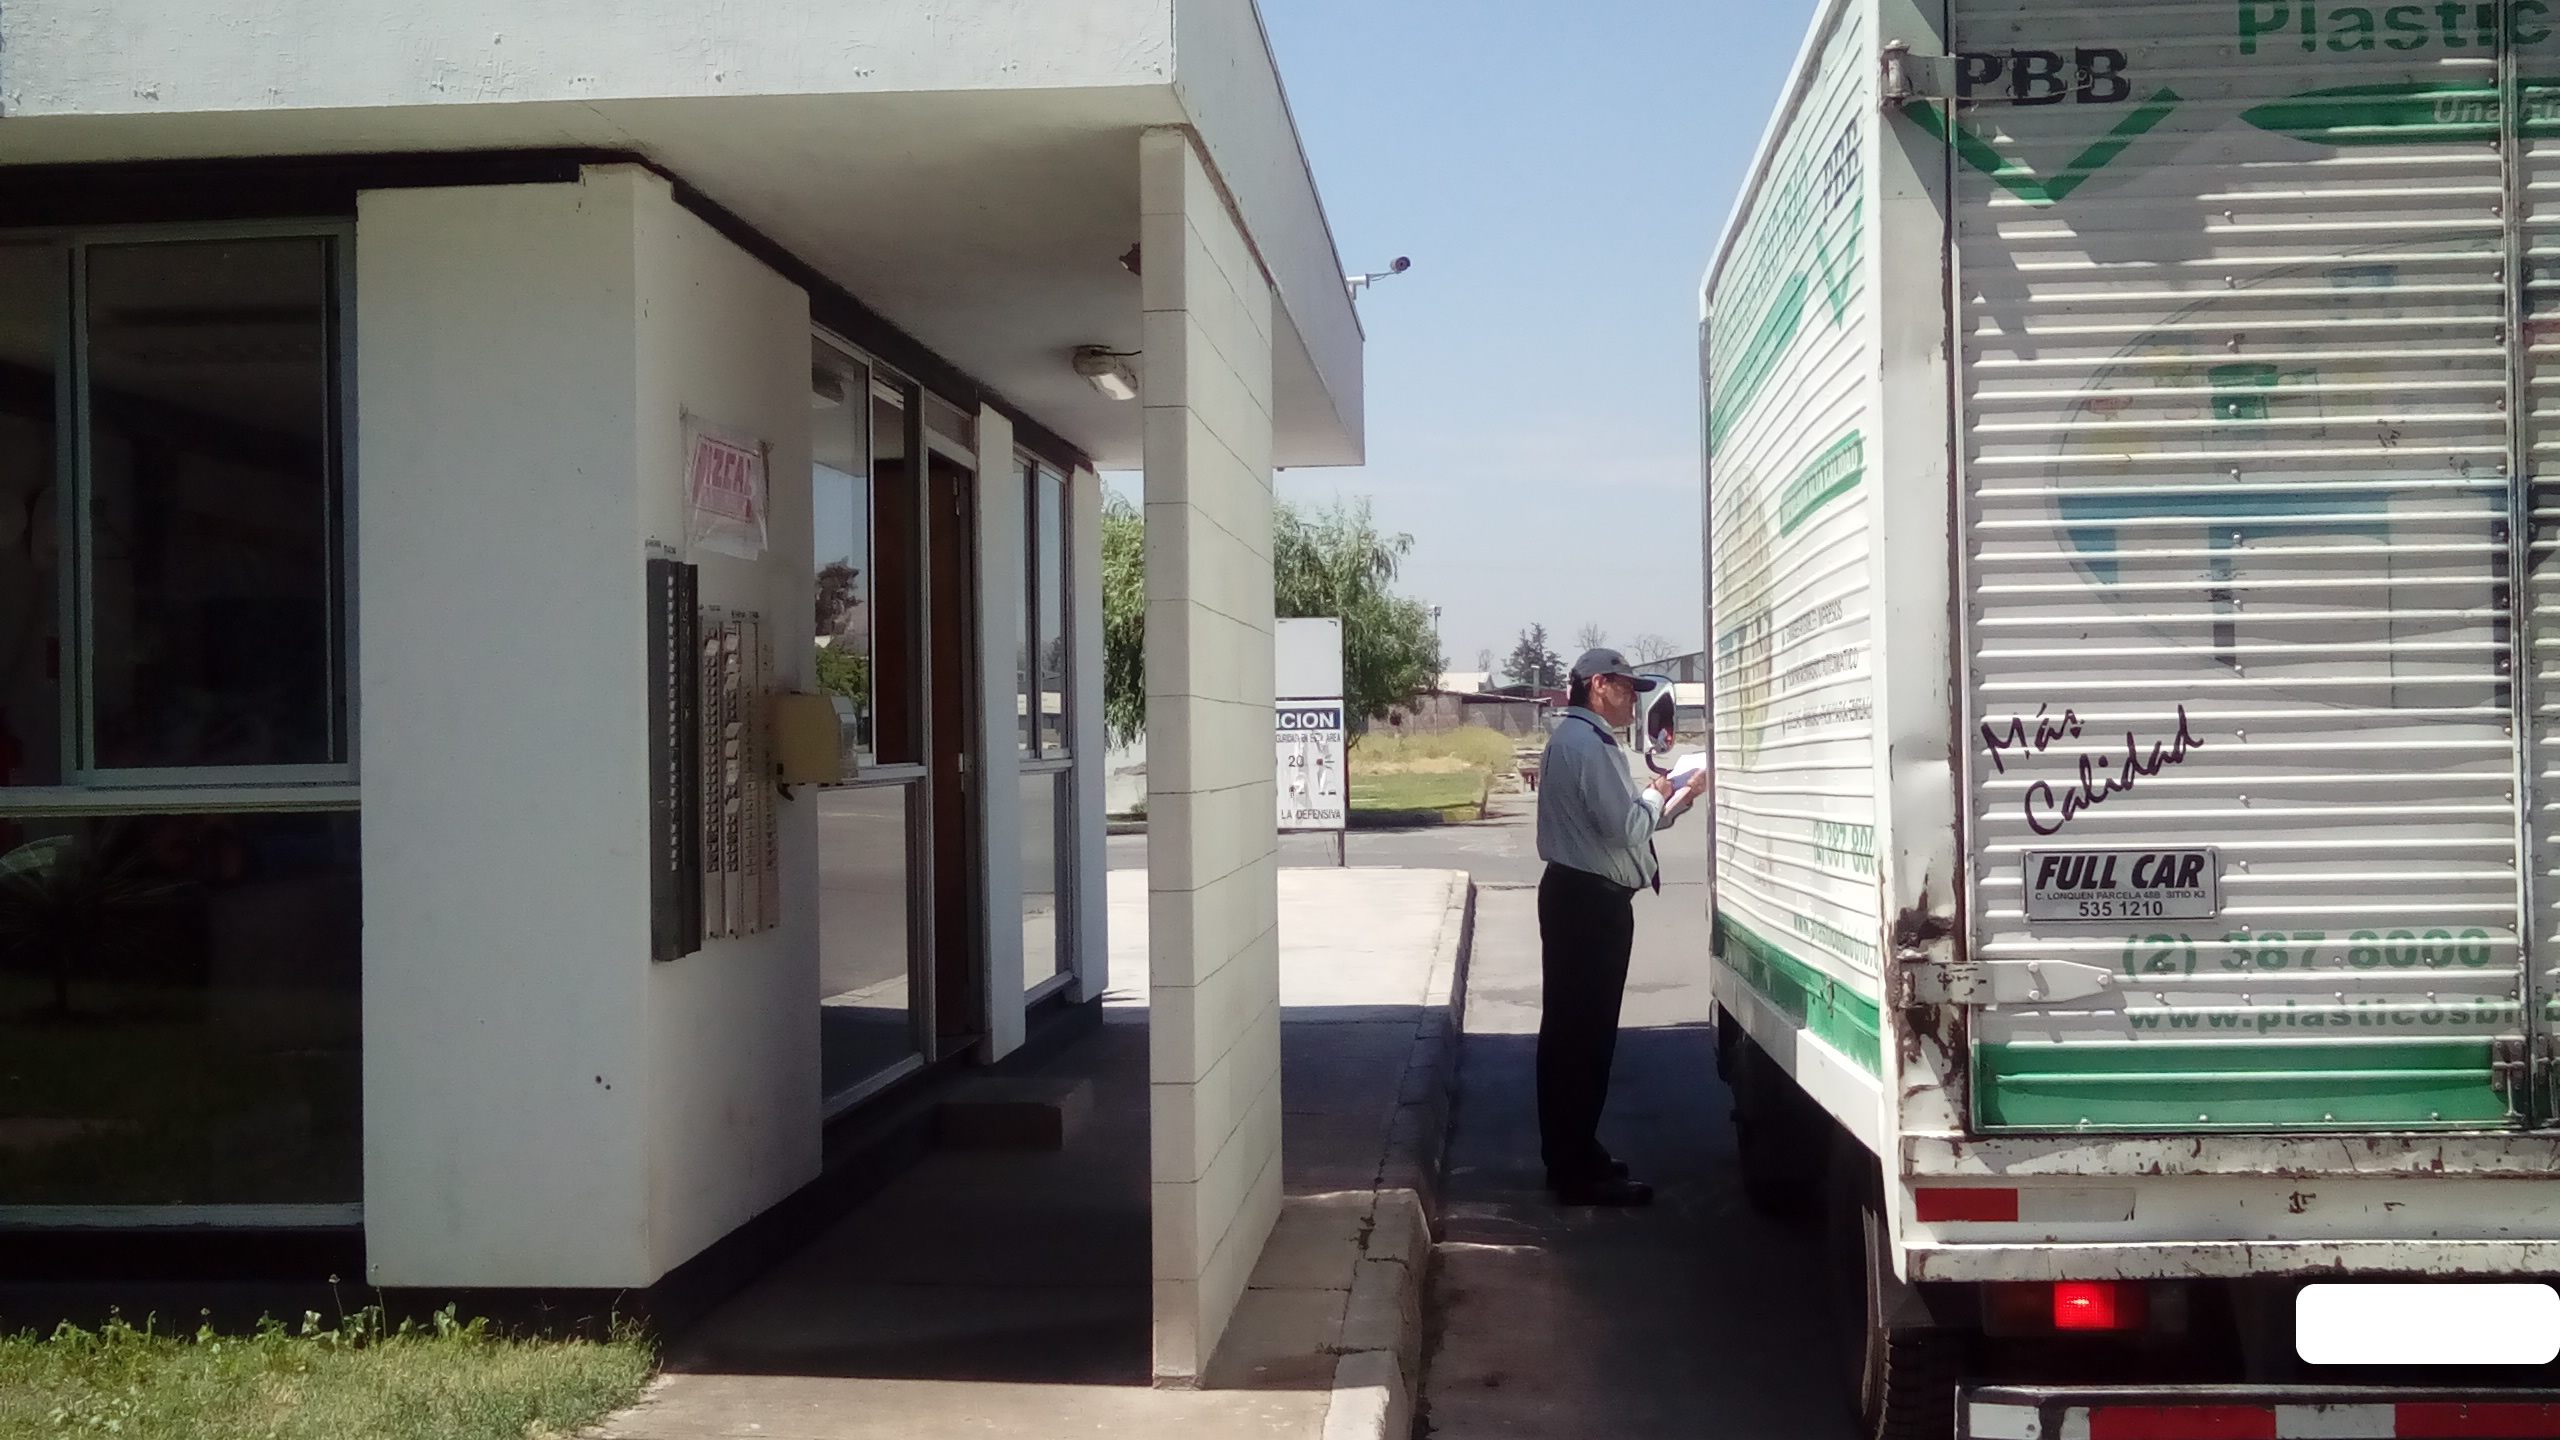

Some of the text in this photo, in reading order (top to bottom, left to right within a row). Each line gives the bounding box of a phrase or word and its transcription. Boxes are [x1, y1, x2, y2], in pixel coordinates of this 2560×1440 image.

[1955, 47, 2131, 110] PBB
[1980, 702, 2084, 774] Más
[2024, 703, 2205, 836] Calidad
[2035, 854, 2205, 890] FULL CAR
[2096, 891, 2142, 900] PARCELA
[2079, 900, 2163, 917] 535 1210
[2122, 928, 2491, 983] (2) 387 8000
